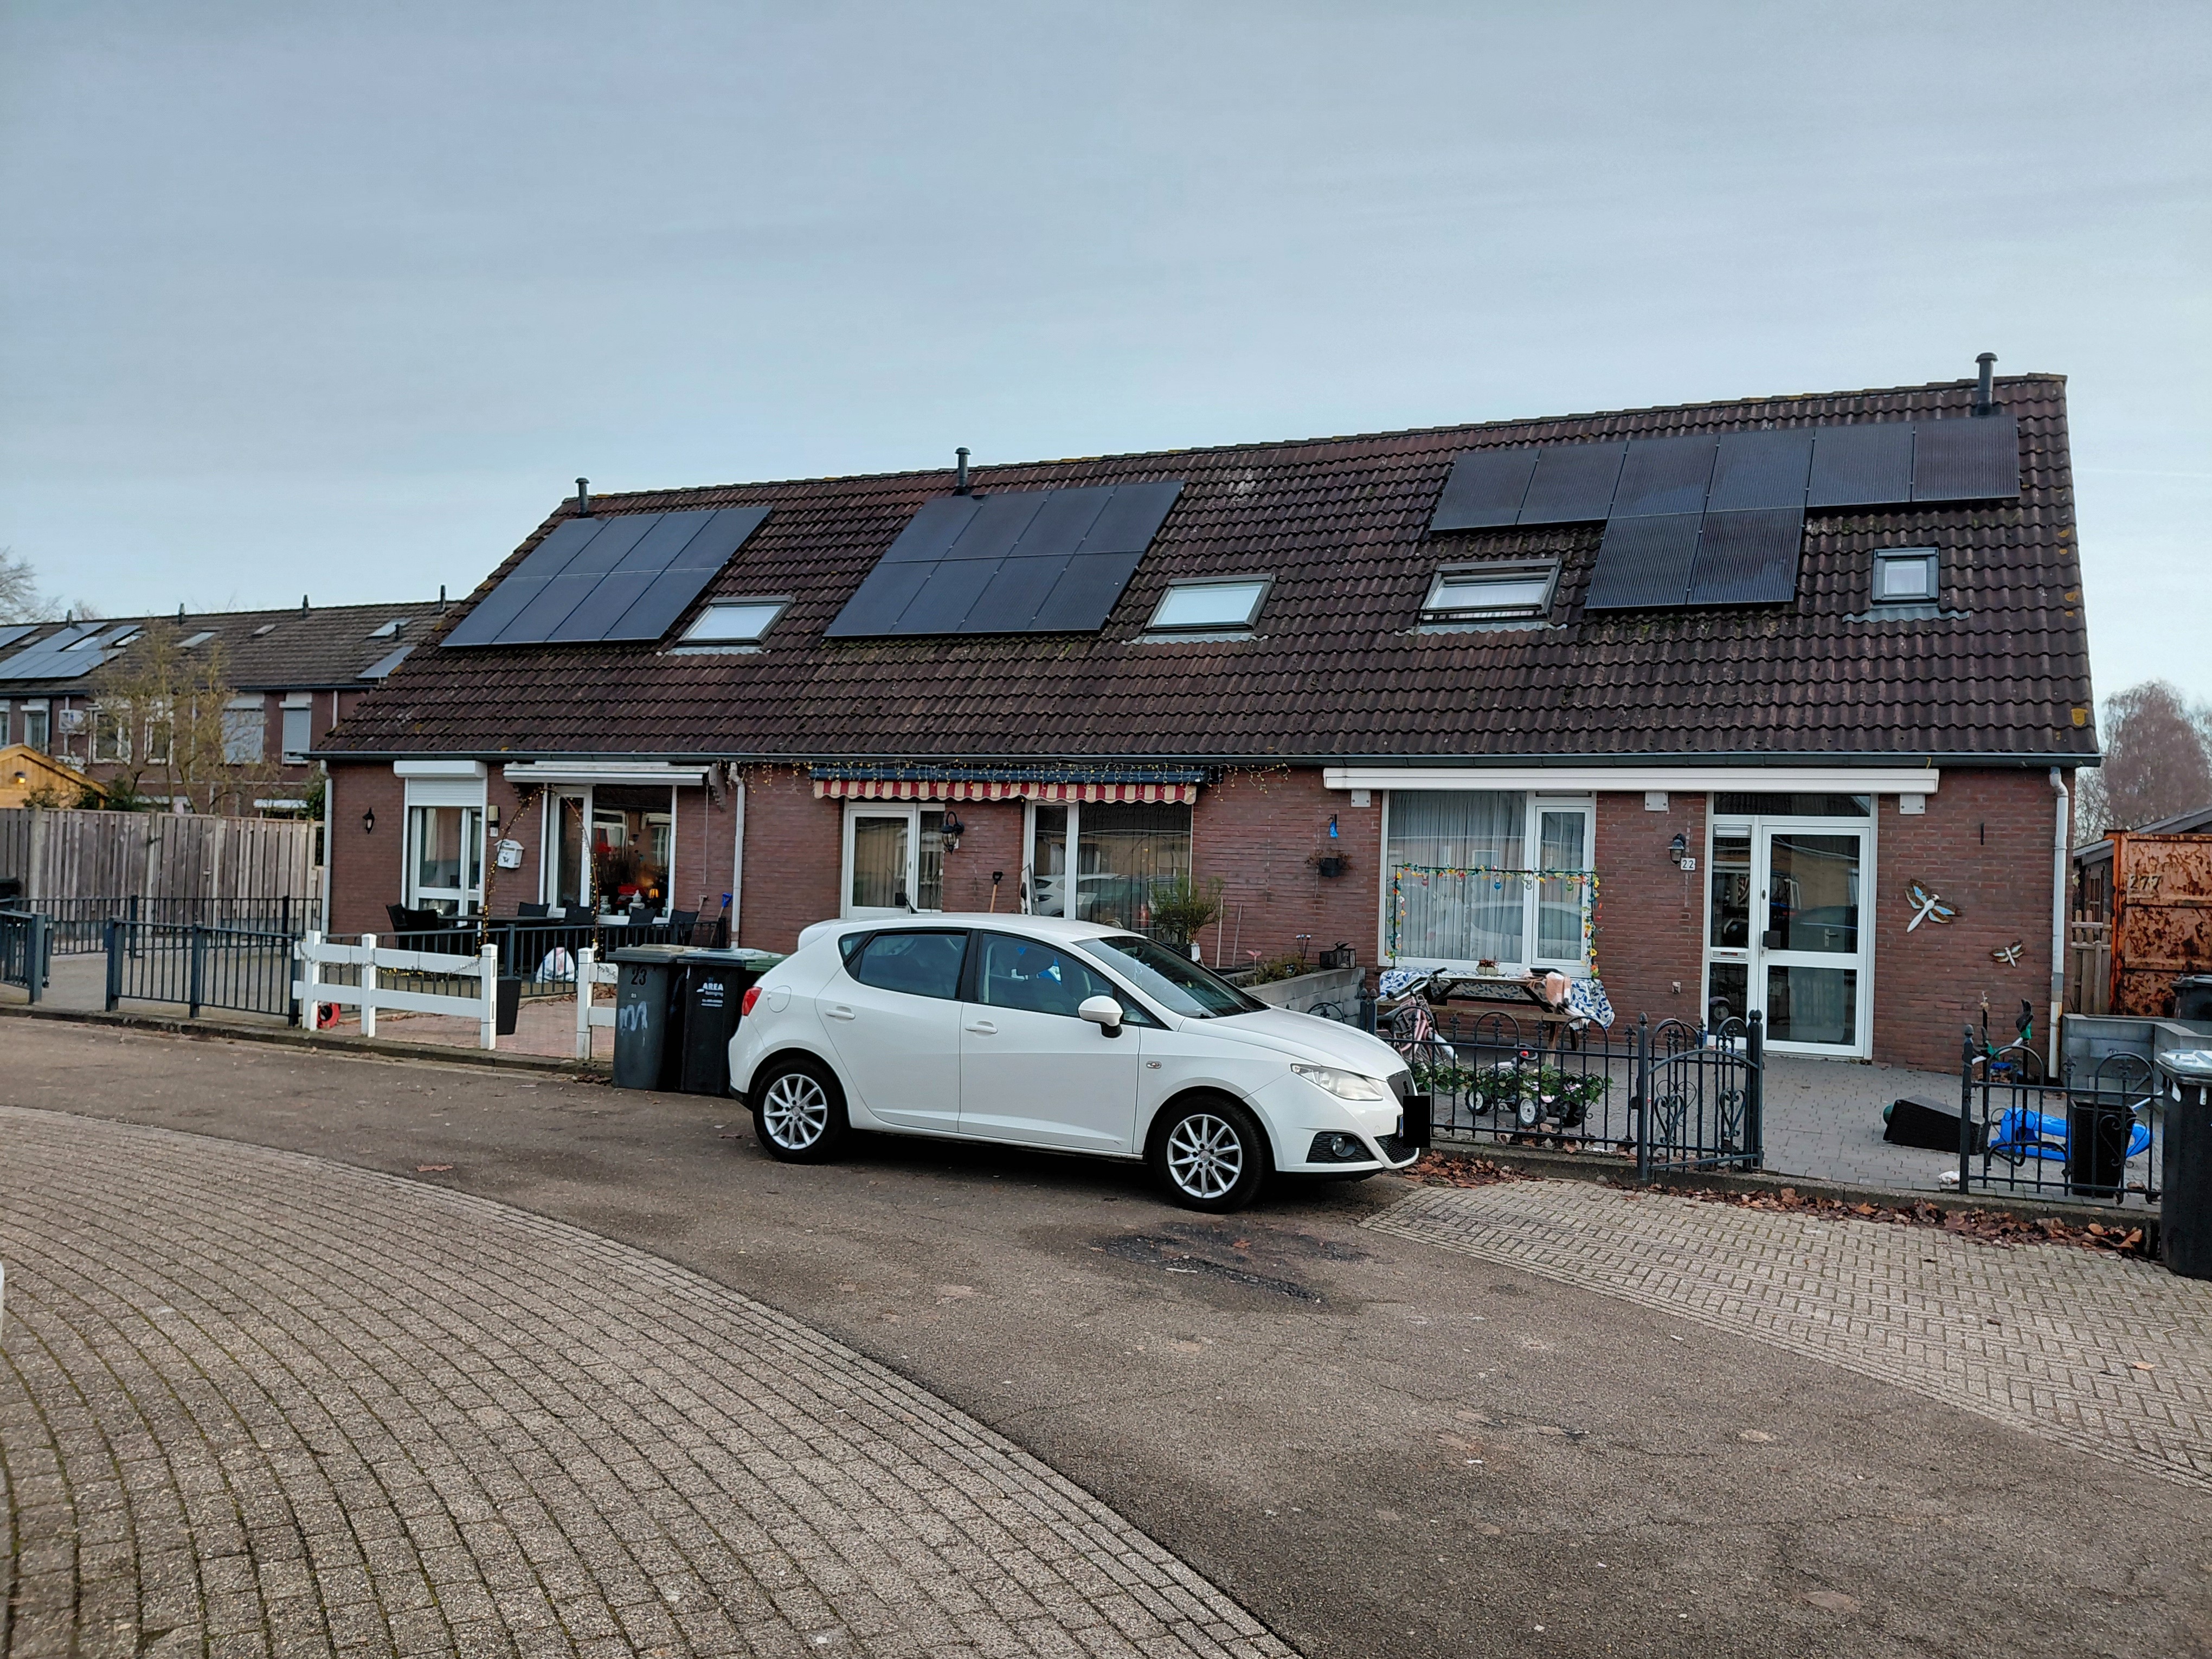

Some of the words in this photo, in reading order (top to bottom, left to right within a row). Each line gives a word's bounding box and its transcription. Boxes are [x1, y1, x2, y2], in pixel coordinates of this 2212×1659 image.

[1682, 859, 1694, 869] 22
[2130, 875, 2162, 890] 277
[631, 968, 647, 986] 23
[703, 982, 724, 991] AREA
